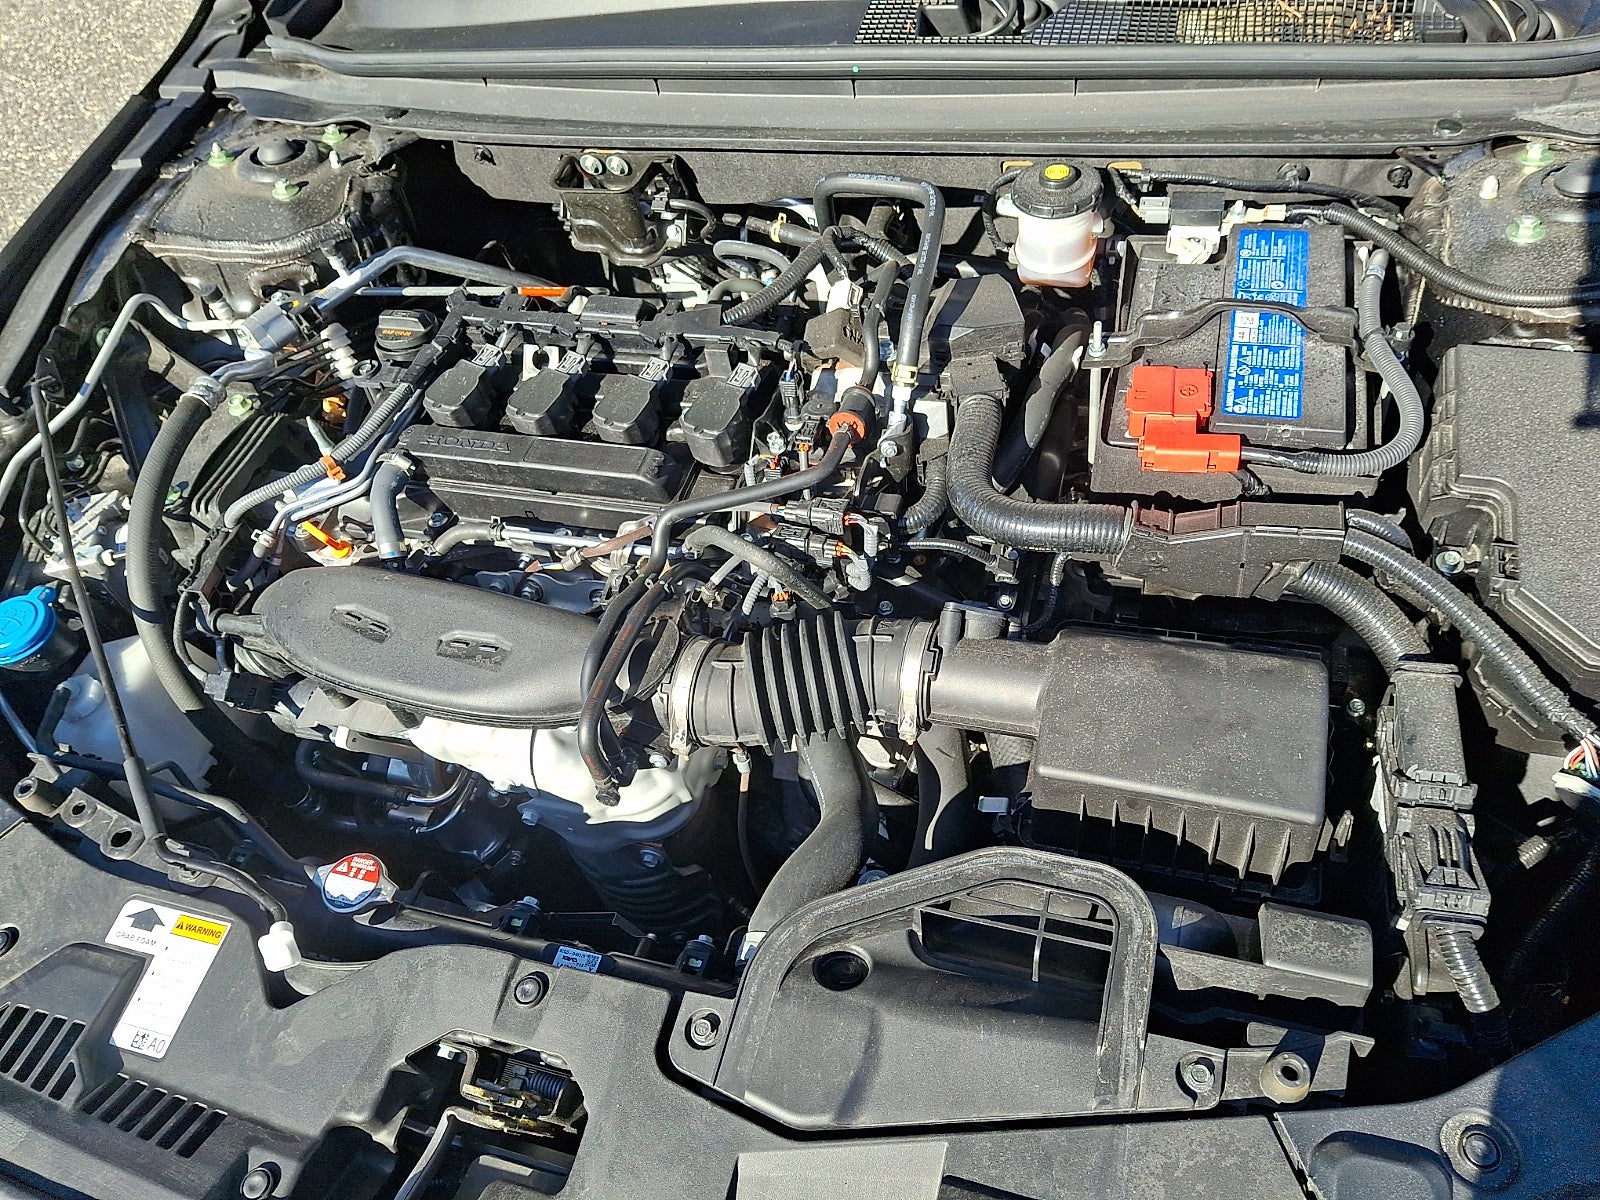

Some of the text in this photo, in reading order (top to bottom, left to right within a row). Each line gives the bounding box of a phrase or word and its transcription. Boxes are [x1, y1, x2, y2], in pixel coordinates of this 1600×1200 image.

[420, 435, 511, 453] HONDA
[185, 923, 222, 938] WARNING
[115, 931, 157, 946] GRAB FOAM
